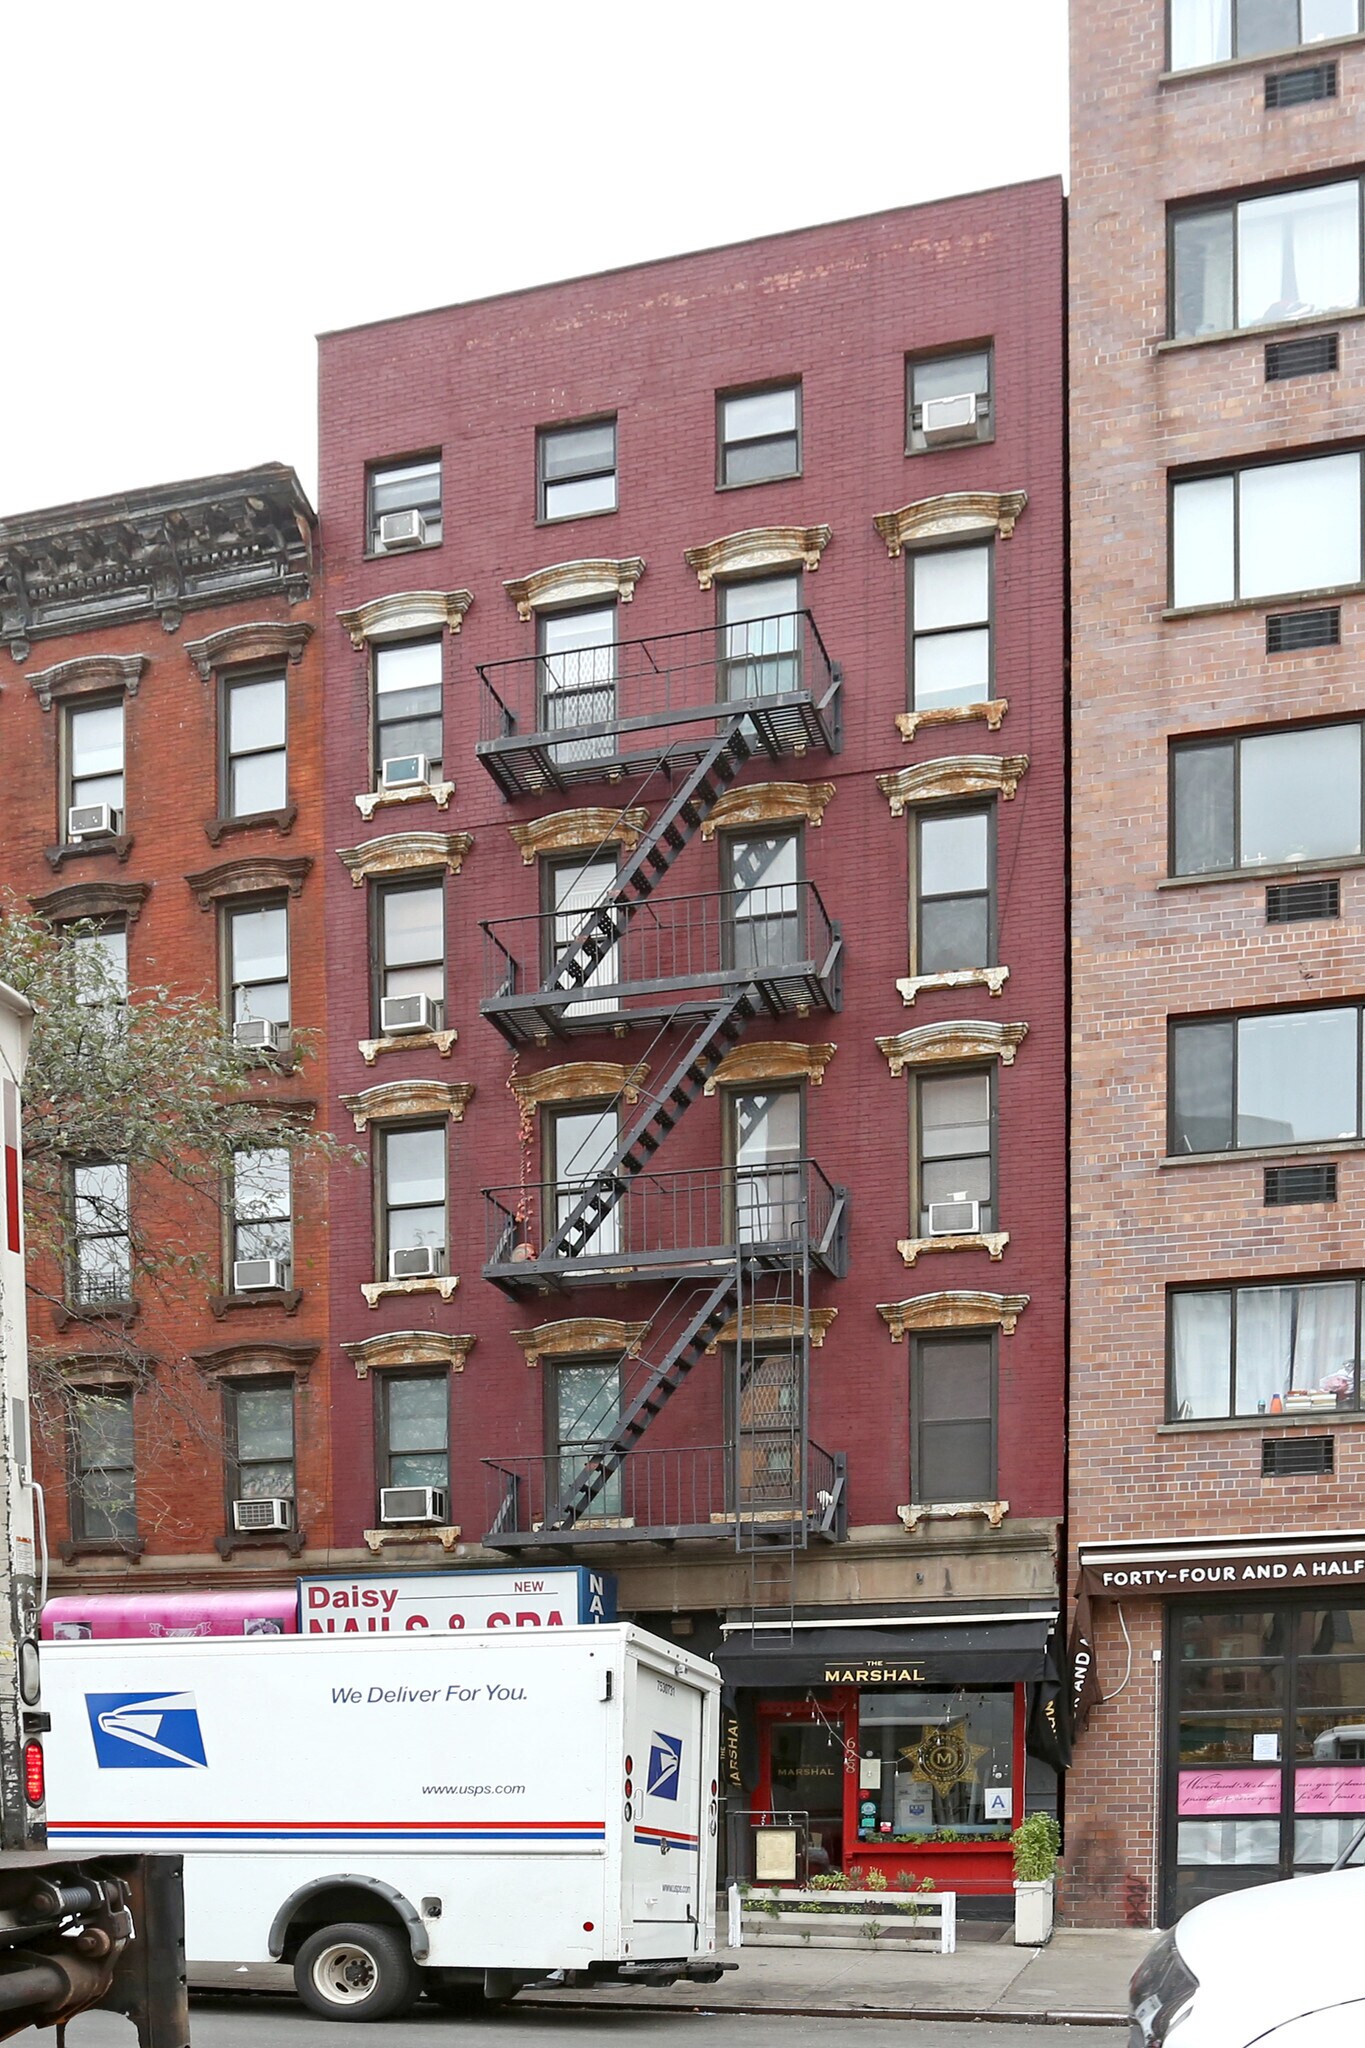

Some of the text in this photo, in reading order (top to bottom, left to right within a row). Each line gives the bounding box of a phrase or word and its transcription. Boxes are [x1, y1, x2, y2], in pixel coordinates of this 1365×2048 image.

[1102, 1559, 1365, 1587] FORTY-FOUR AND A HALF
[513, 1580, 545, 1593] NEW
[307, 1585, 399, 1613] Daisy
[825, 1669, 926, 1682] MARSHAL
[1074, 1651, 1091, 1692] AND
[331, 1683, 528, 1704] We Deliver For You.
[936, 1752, 952, 1764] M
[777, 1768, 835, 1776] MARSHAL
[422, 1784, 526, 1797] www.usps.com
[991, 1794, 1006, 1809] A
